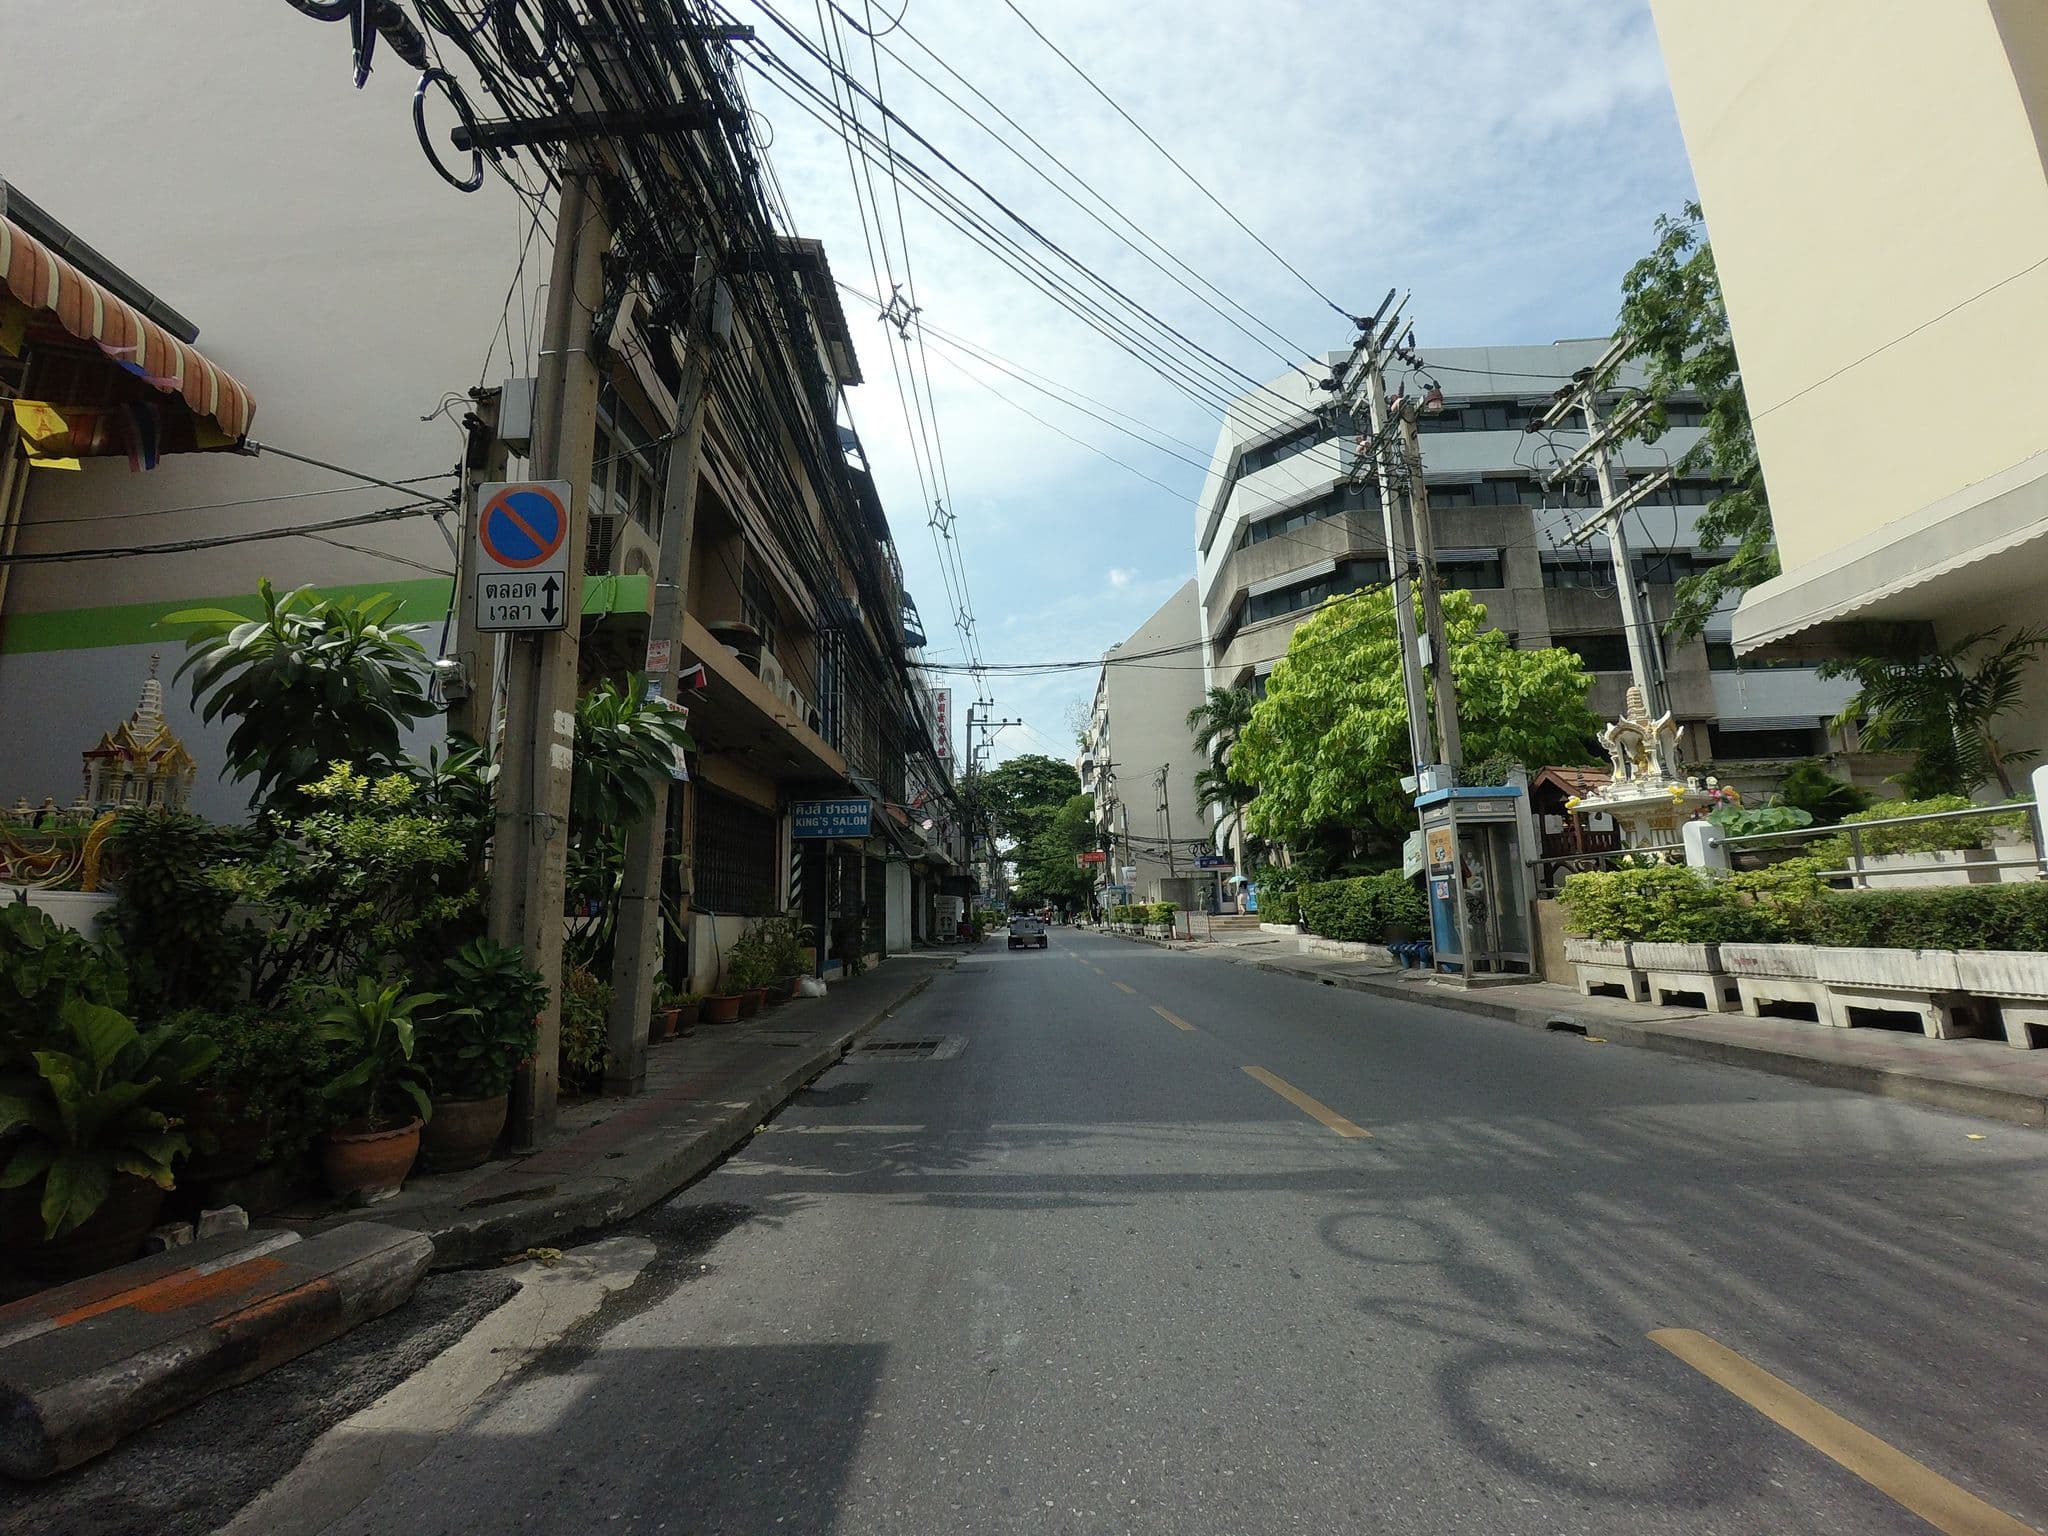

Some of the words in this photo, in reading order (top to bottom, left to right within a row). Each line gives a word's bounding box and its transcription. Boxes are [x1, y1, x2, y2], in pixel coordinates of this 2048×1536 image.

[486, 582, 537, 599] ตลอด
[490, 604, 532, 620] เวลา
[825, 803, 867, 815] ซาลอน
[796, 817, 829, 827] KING'S
[832, 816, 867, 826] SALON
